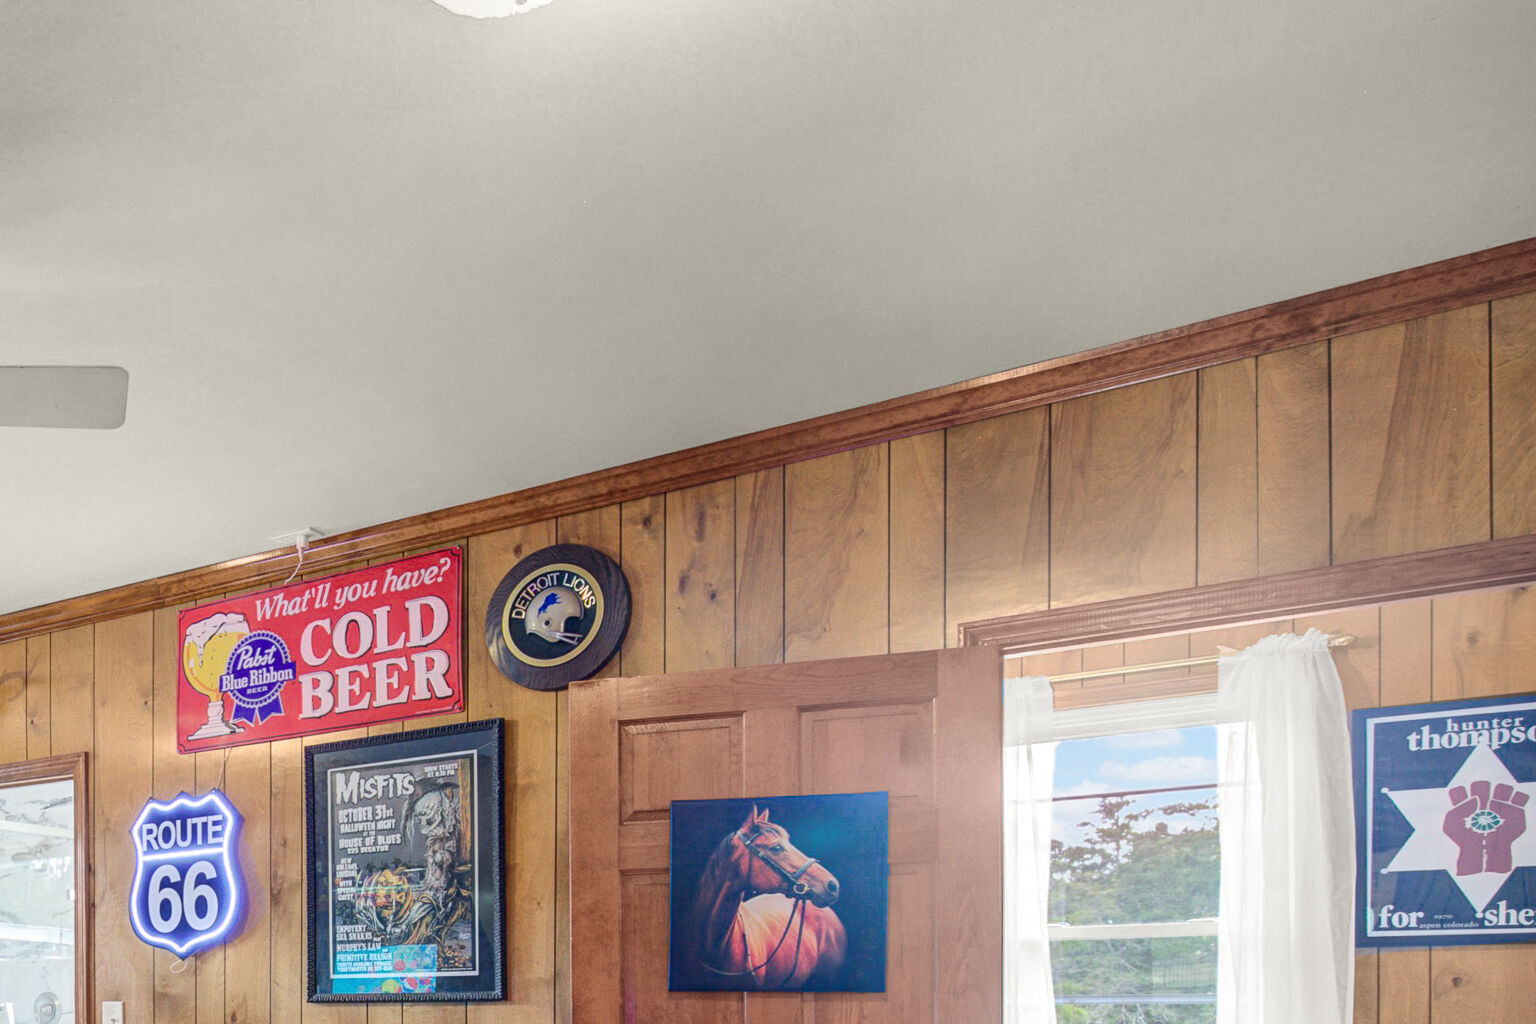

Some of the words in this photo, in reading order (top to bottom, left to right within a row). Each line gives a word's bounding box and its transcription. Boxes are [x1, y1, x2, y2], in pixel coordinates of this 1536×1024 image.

[255, 582, 331, 622] What'll
[333, 579, 377, 610] you
[381, 557, 451, 595] have?
[511, 572, 561, 620] DETROIT
[562, 572, 596, 609] LIONS
[300, 595, 450, 667] COLD
[237, 644, 277, 671] Pabst
[221, 672, 248, 693] Blue
[249, 666, 294, 688] Ribbon
[246, 685, 269, 694] BEER
[298, 648, 454, 720] BEER
[1447, 717, 1525, 732] hunter
[438, 763, 458, 771] STARTS
[338, 806, 373, 824] OCTOBER
[374, 804, 394, 820] 31st
[141, 814, 224, 851] ROUTE
[339, 821, 376, 834] HALLOWEEN
[376, 819, 396, 831] NIGHT
[338, 837, 363, 849] HOUSE
[364, 836, 375, 847] OF
[377, 833, 402, 846] BLUES
[148, 860, 219, 934] 66
[1379, 904, 1425, 928] for
[1484, 899, 1536, 927] she
[336, 924, 367, 933] IMPOTENT
[336, 933, 348, 942] SEA
[348, 931, 373, 941] SNAKES
[336, 953, 369, 962] PRIMITIVE
[369, 952, 393, 961] REASON
[367, 942, 382, 951] LAW
